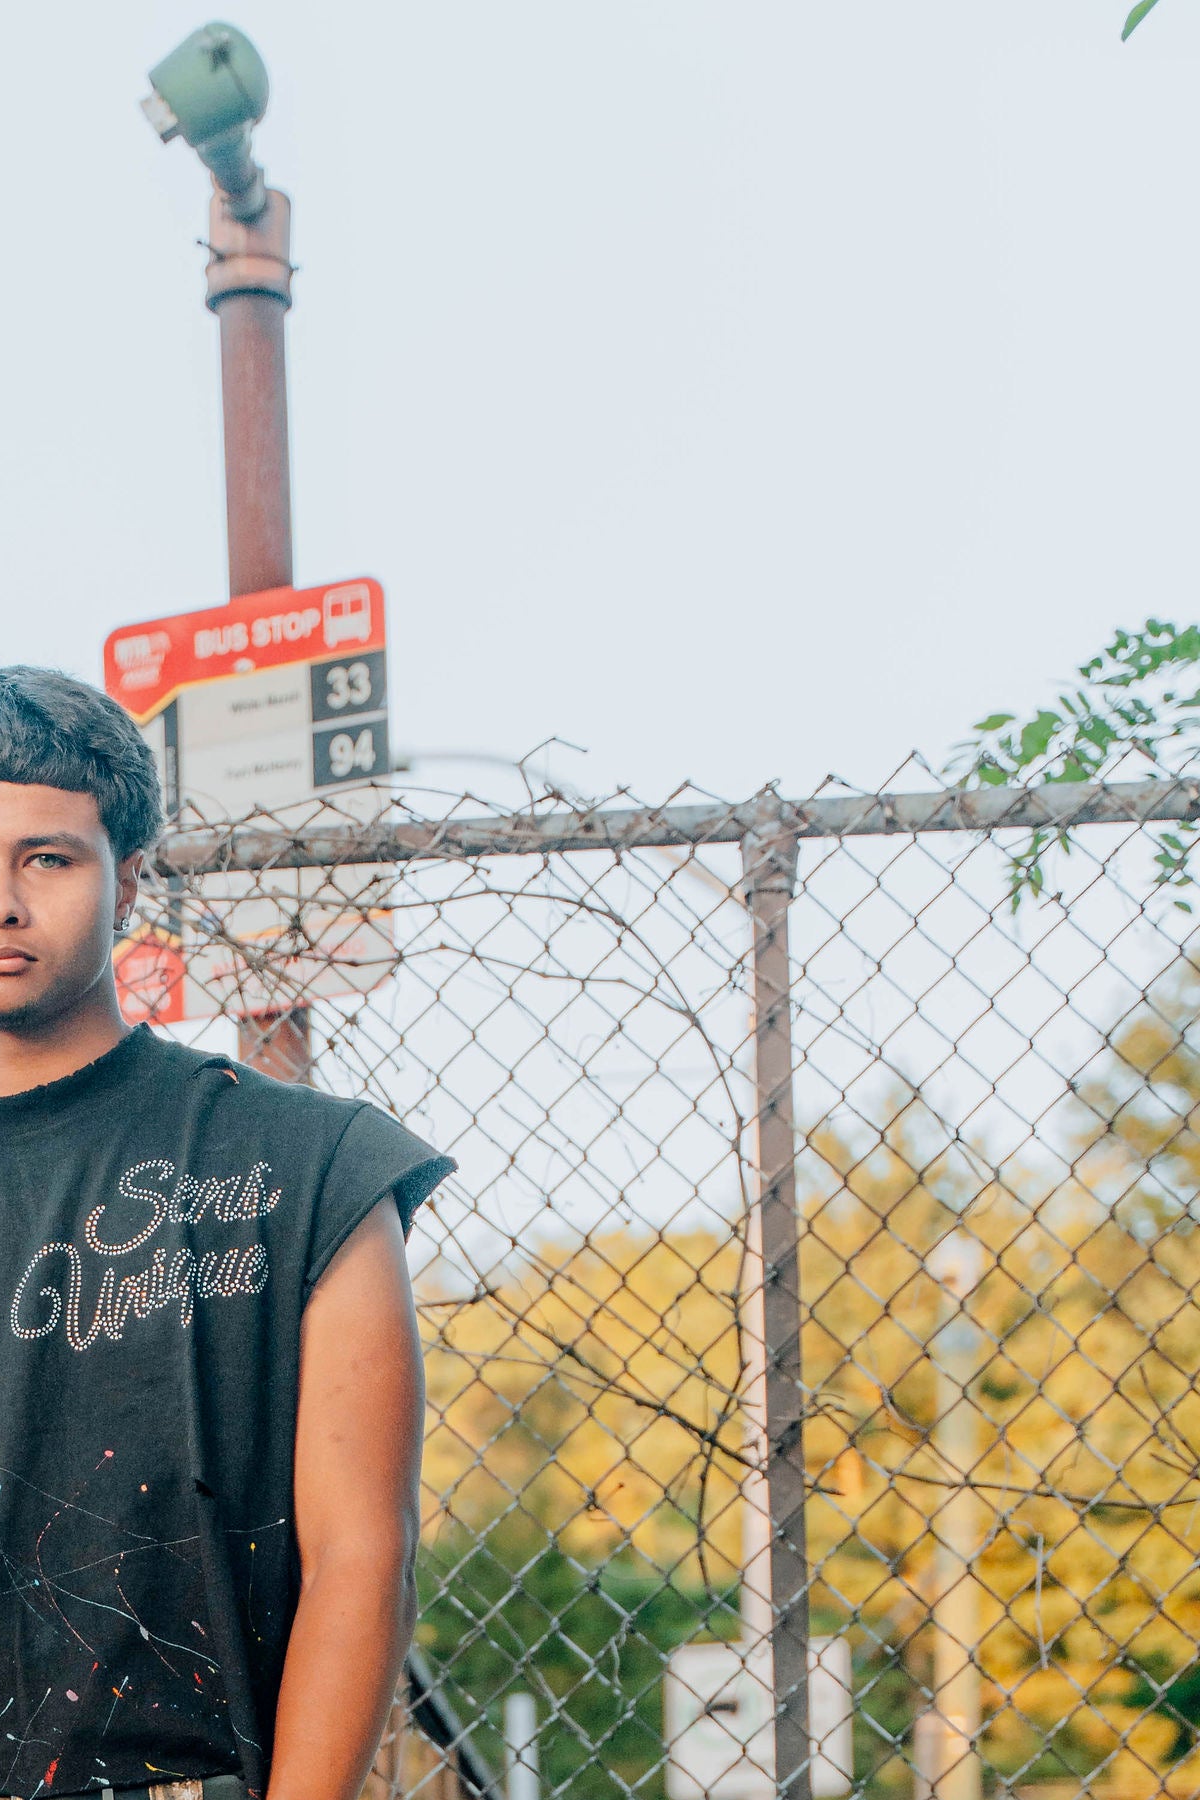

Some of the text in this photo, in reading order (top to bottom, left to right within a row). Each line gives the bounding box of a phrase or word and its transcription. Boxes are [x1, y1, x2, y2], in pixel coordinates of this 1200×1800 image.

[194, 607, 321, 659] BUS STOP
[326, 661, 372, 710] 33
[329, 728, 377, 778] 94
[10, 1243, 270, 1352] Unique
